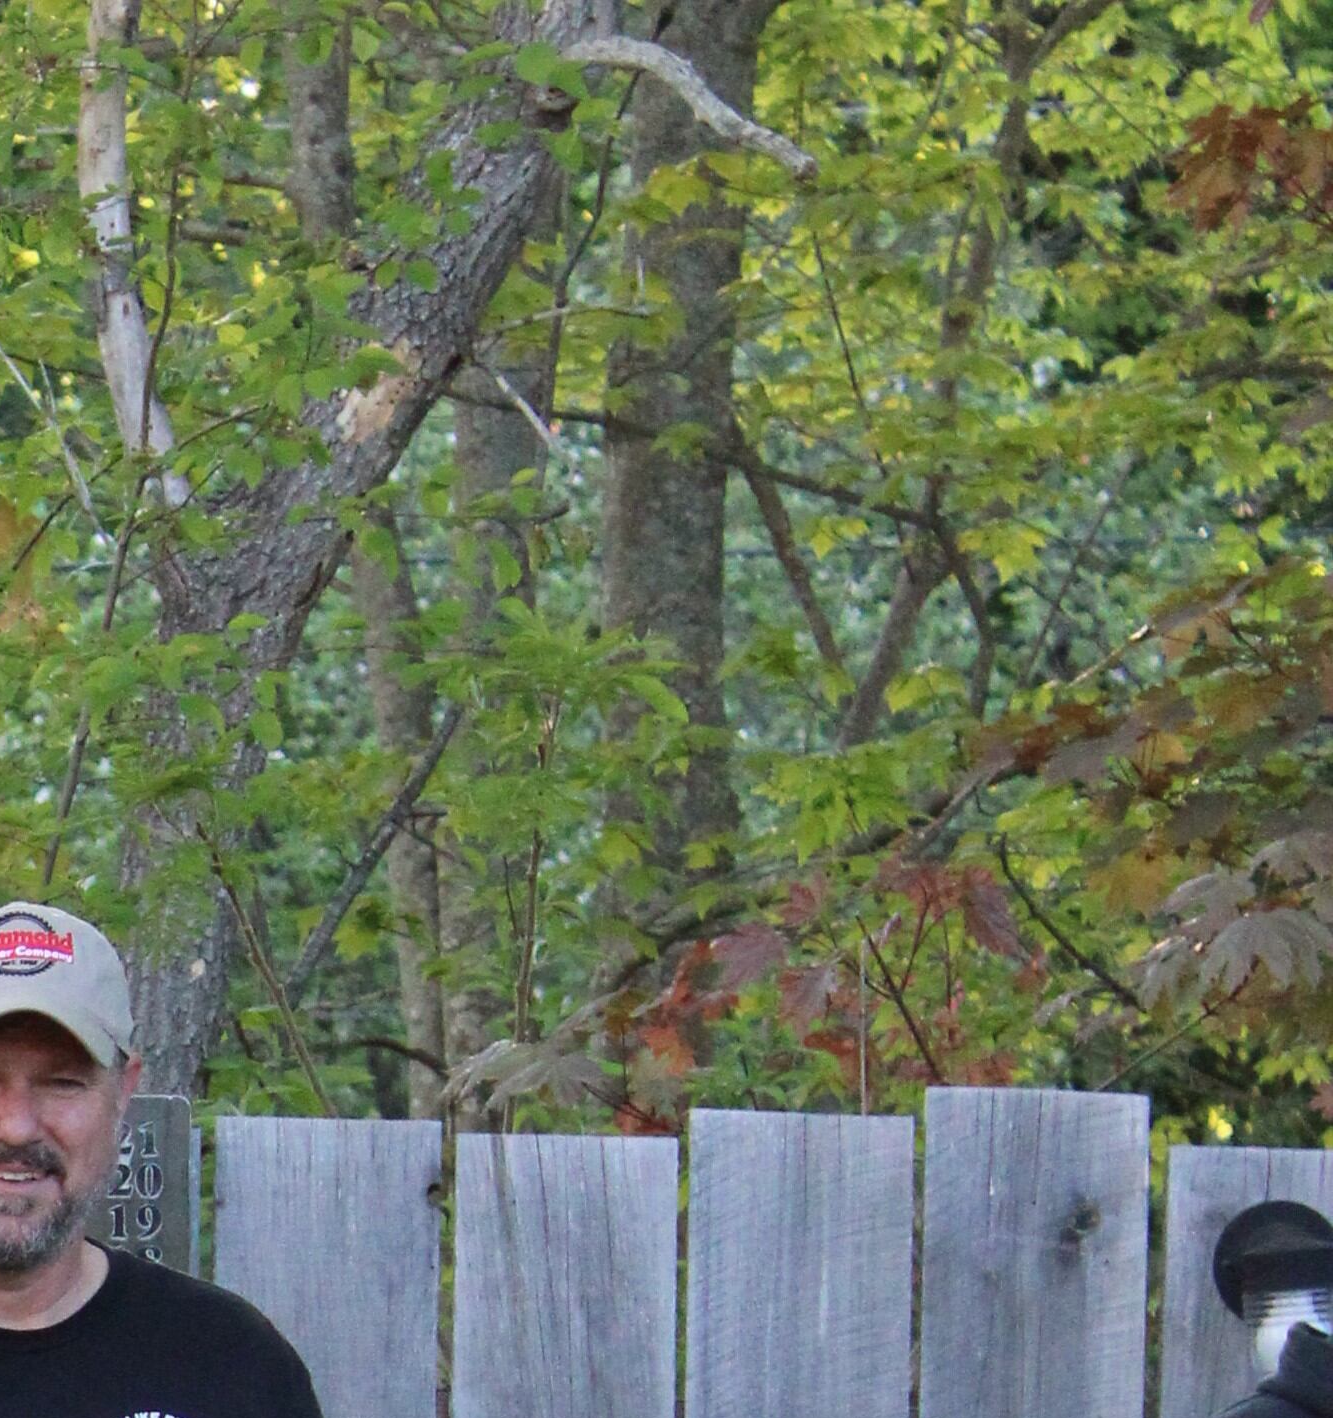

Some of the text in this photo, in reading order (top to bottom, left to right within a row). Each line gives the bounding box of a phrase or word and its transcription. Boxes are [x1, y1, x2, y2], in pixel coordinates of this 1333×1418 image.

[15, 945, 73, 963] Company
[107, 1163, 164, 1199] 20
[109, 1204, 164, 1241] 19
